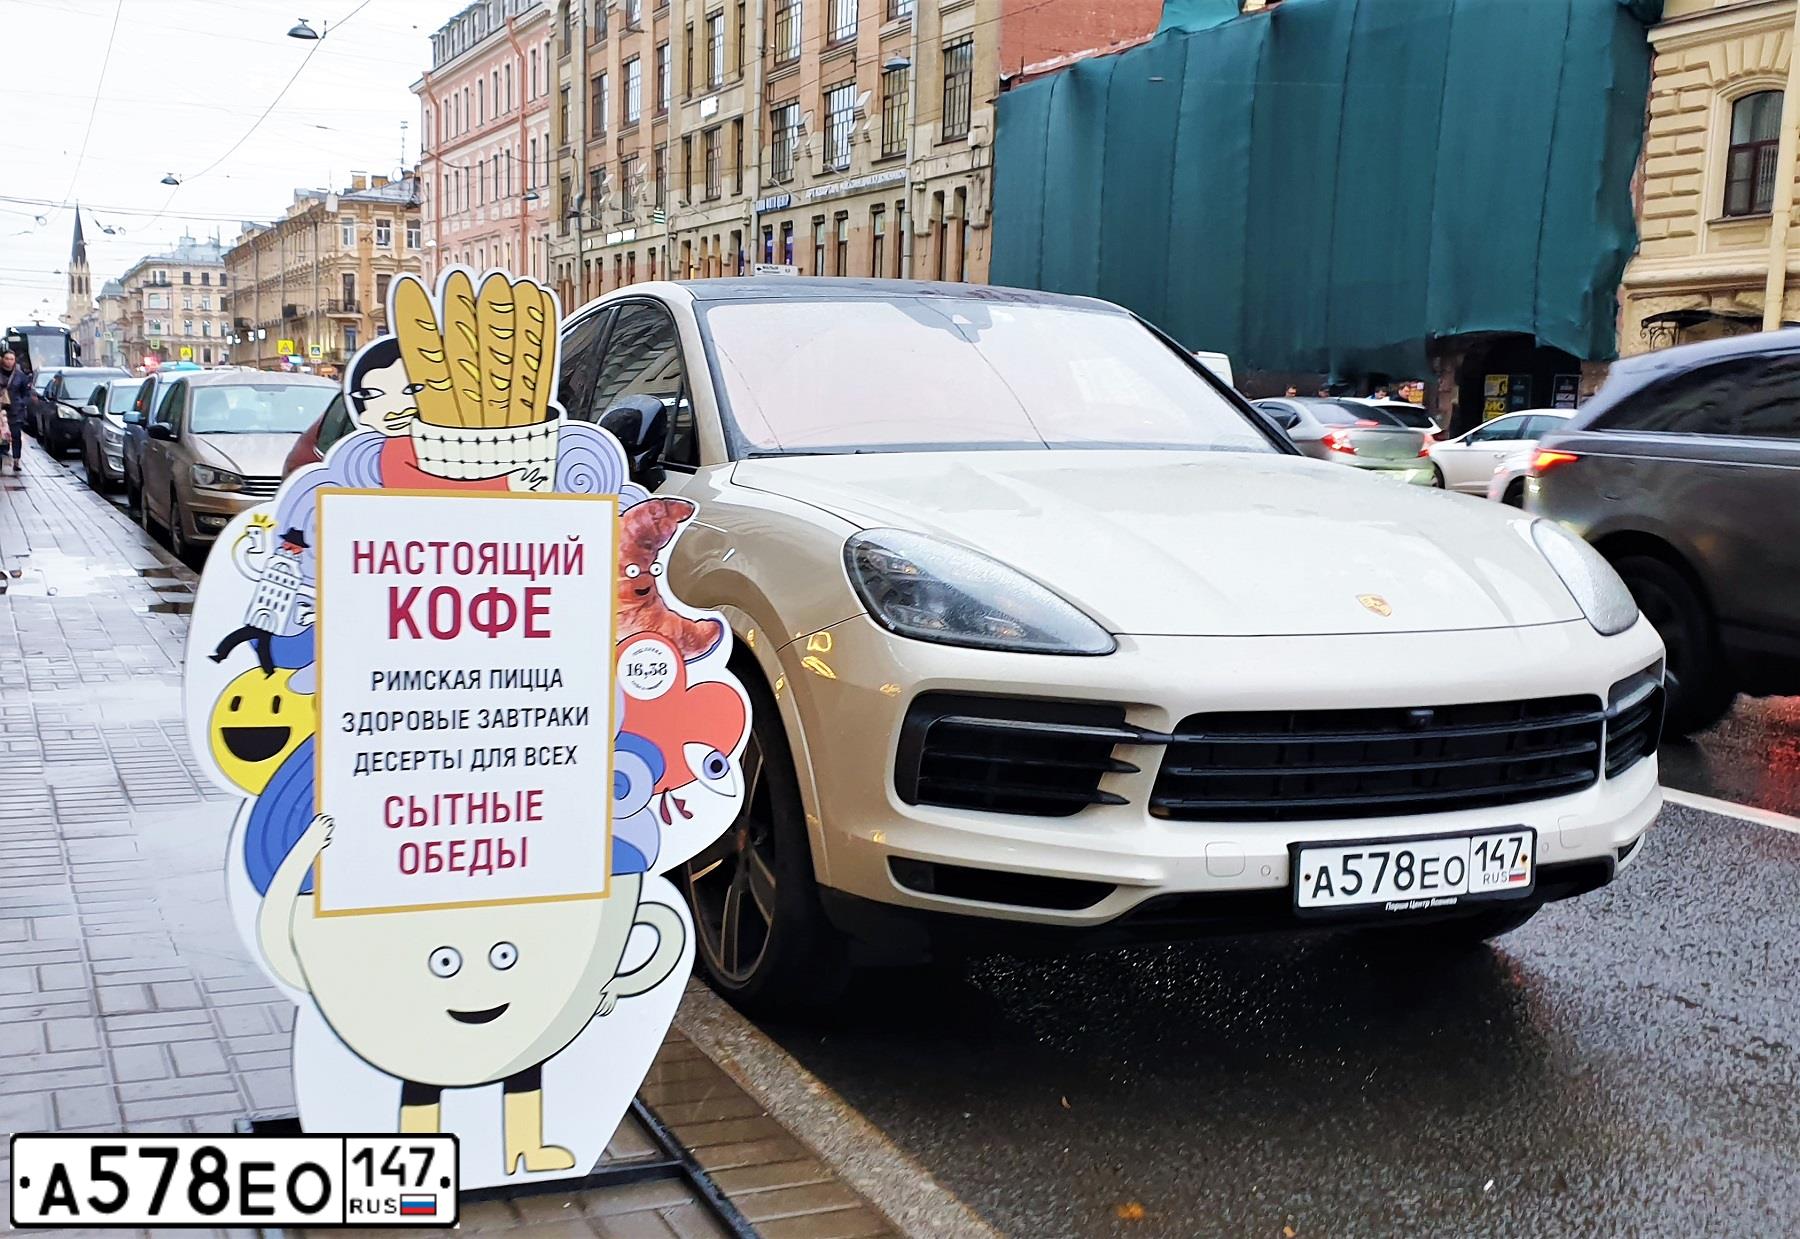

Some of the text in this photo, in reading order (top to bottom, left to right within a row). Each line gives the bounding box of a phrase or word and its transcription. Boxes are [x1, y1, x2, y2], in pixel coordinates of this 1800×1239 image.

[352, 535, 584, 581] НАСТОЯЩИЙ
[387, 586, 551, 640] КОФЕ
[371, 668, 563, 691] РИМСКАЯ ПИЦЦА
[625, 662, 668, 679] 16,38
[342, 706, 588, 736] ЗДОРОВЫЕ ЗАВТРАКИ
[353, 745, 578, 776] ДЕСЕРТЫ ДЛЯ ВСЕХ
[384, 790, 544, 828] СЫТНЫЕ
[399, 837, 527, 877] ОБЕДЫ
[1474, 837, 1523, 872] 147
[1483, 872, 1508, 884] RUS
